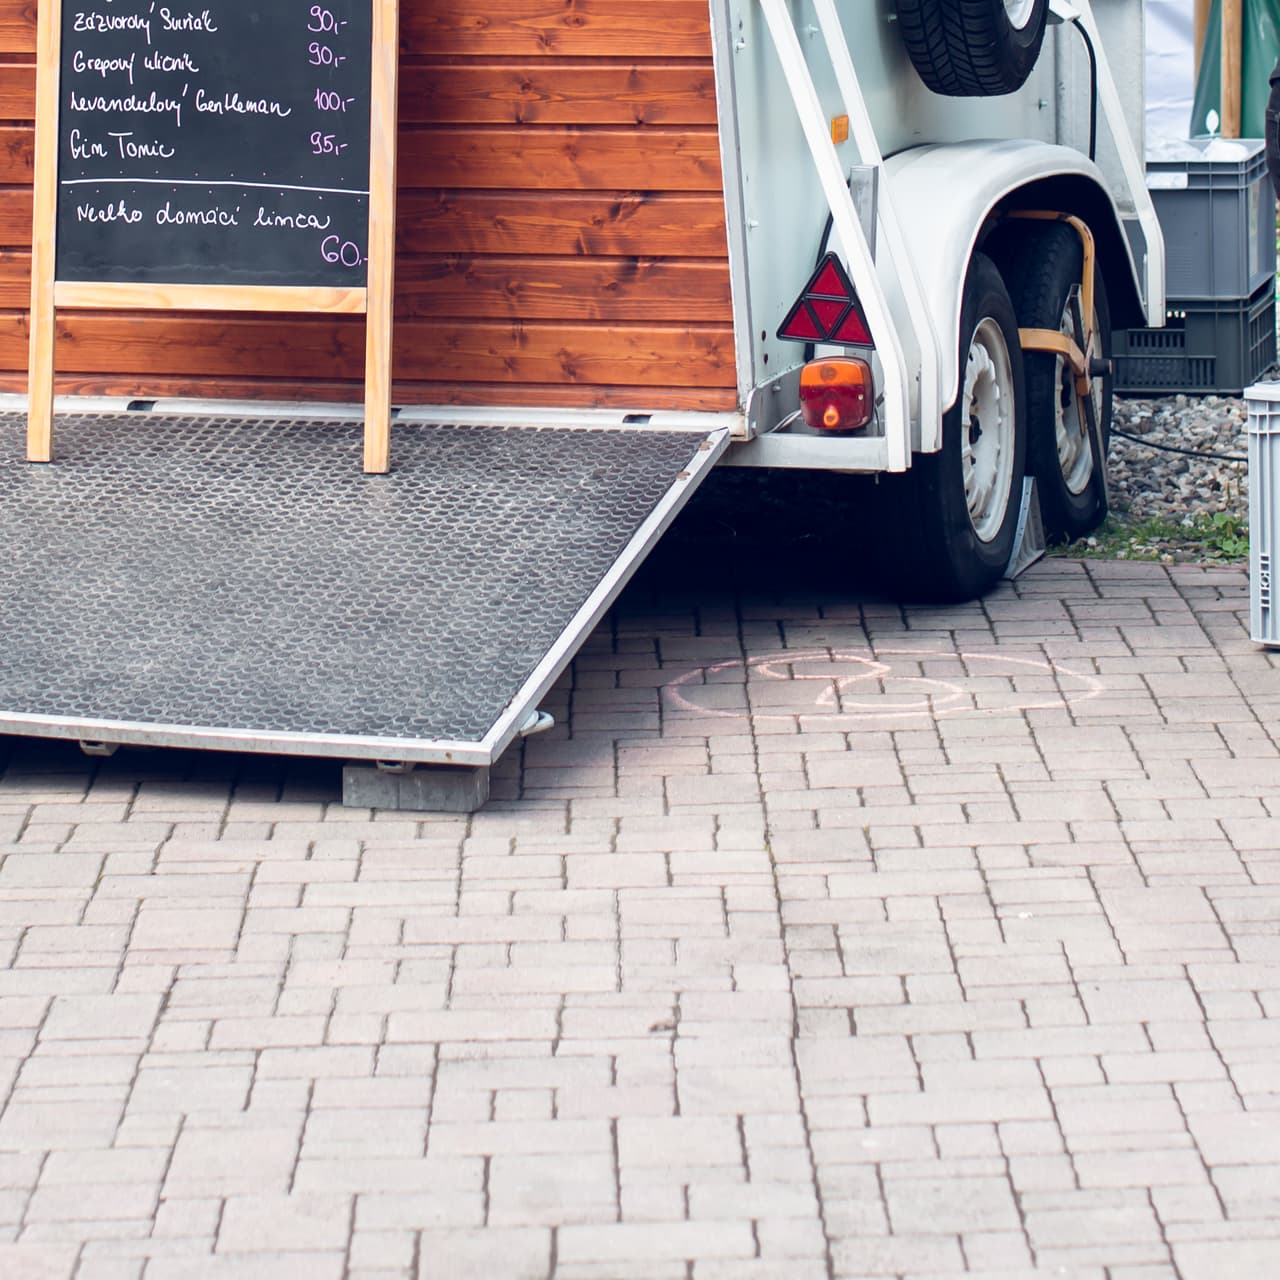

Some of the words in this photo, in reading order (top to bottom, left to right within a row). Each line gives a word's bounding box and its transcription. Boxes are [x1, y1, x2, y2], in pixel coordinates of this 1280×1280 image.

[195, 88, 291, 117] Gentleman
[70, 128, 108, 160] Gin
[107, 131, 175, 158] Tonic
[76, 200, 143, 223] Nealko
